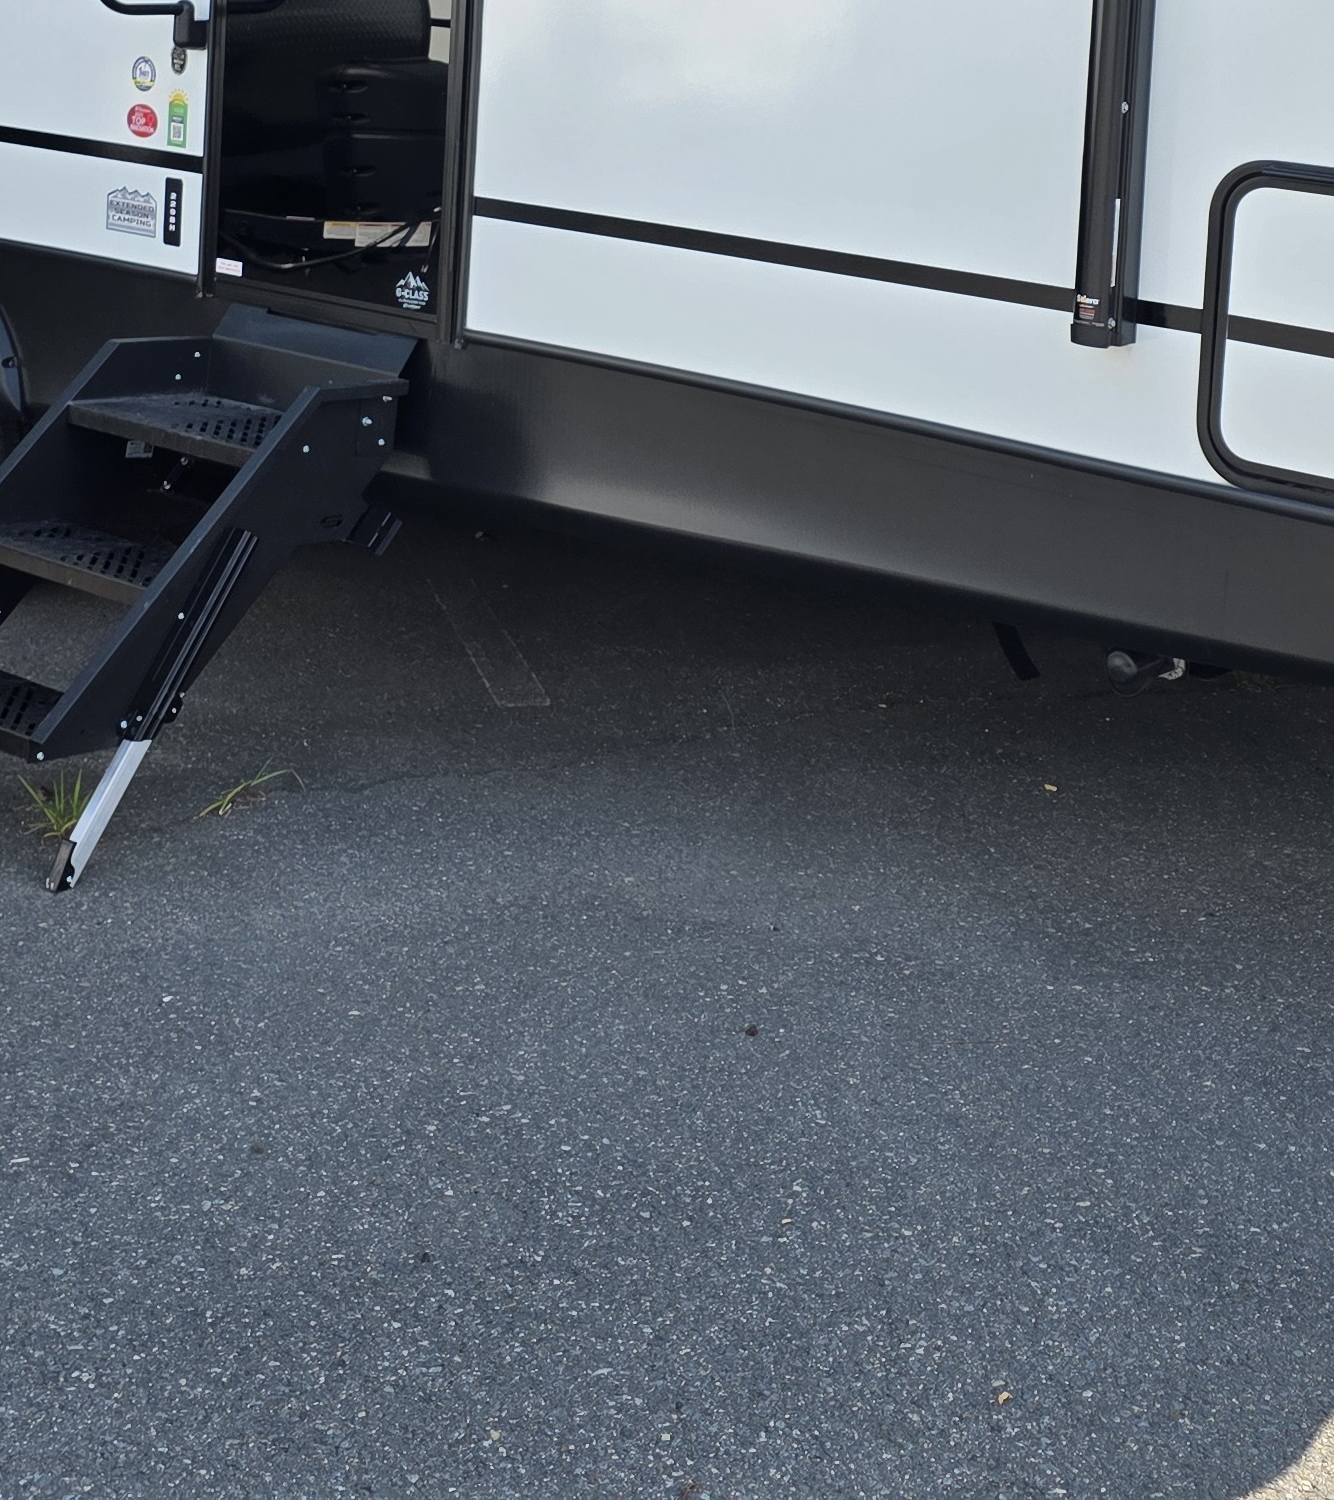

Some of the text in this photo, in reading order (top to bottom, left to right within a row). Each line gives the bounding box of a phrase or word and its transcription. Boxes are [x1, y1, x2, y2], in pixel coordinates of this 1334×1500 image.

[110, 199, 154, 213] EXTENDED
[111, 214, 152, 228] CAMPING
[114, 208, 149, 220] SEASON
